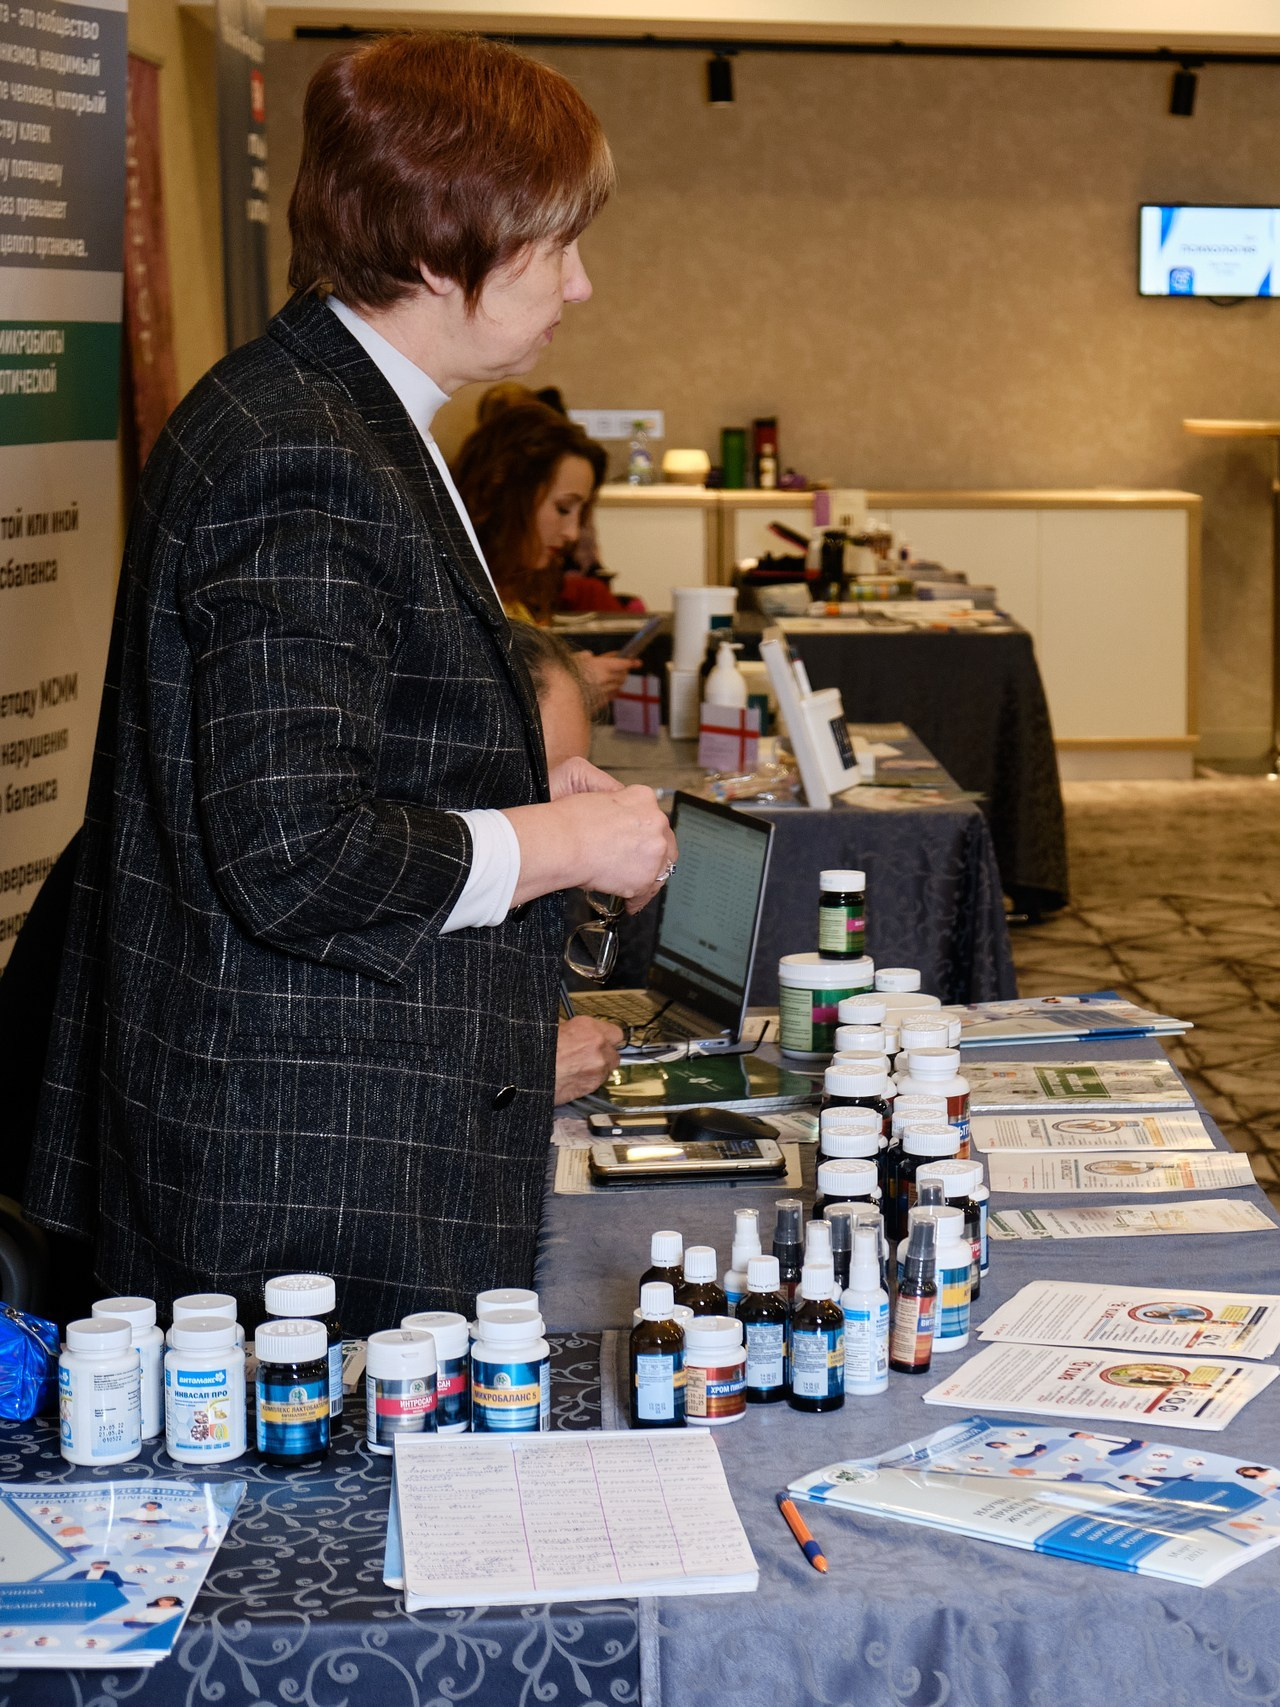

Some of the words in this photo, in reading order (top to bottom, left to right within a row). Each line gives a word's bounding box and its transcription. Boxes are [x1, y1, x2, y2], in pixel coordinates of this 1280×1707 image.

[36, 9, 100, 41] сообщество
[56, 88, 107, 117] который
[27, 511, 48, 536] или
[52, 501, 79, 533] иной
[174, 1390, 210, 1400] ИНВАСАП
[211, 1390, 228, 1399] ПРО
[710, 1383, 730, 1394] ХРОМ
[400, 1395, 433, 1409] ИНТРОСАН
[473, 1391, 531, 1403] МИКРОБАЛАНС
[532, 1391, 538, 1400] 5
[262, 1404, 291, 1414] КОМПЛЕКС
